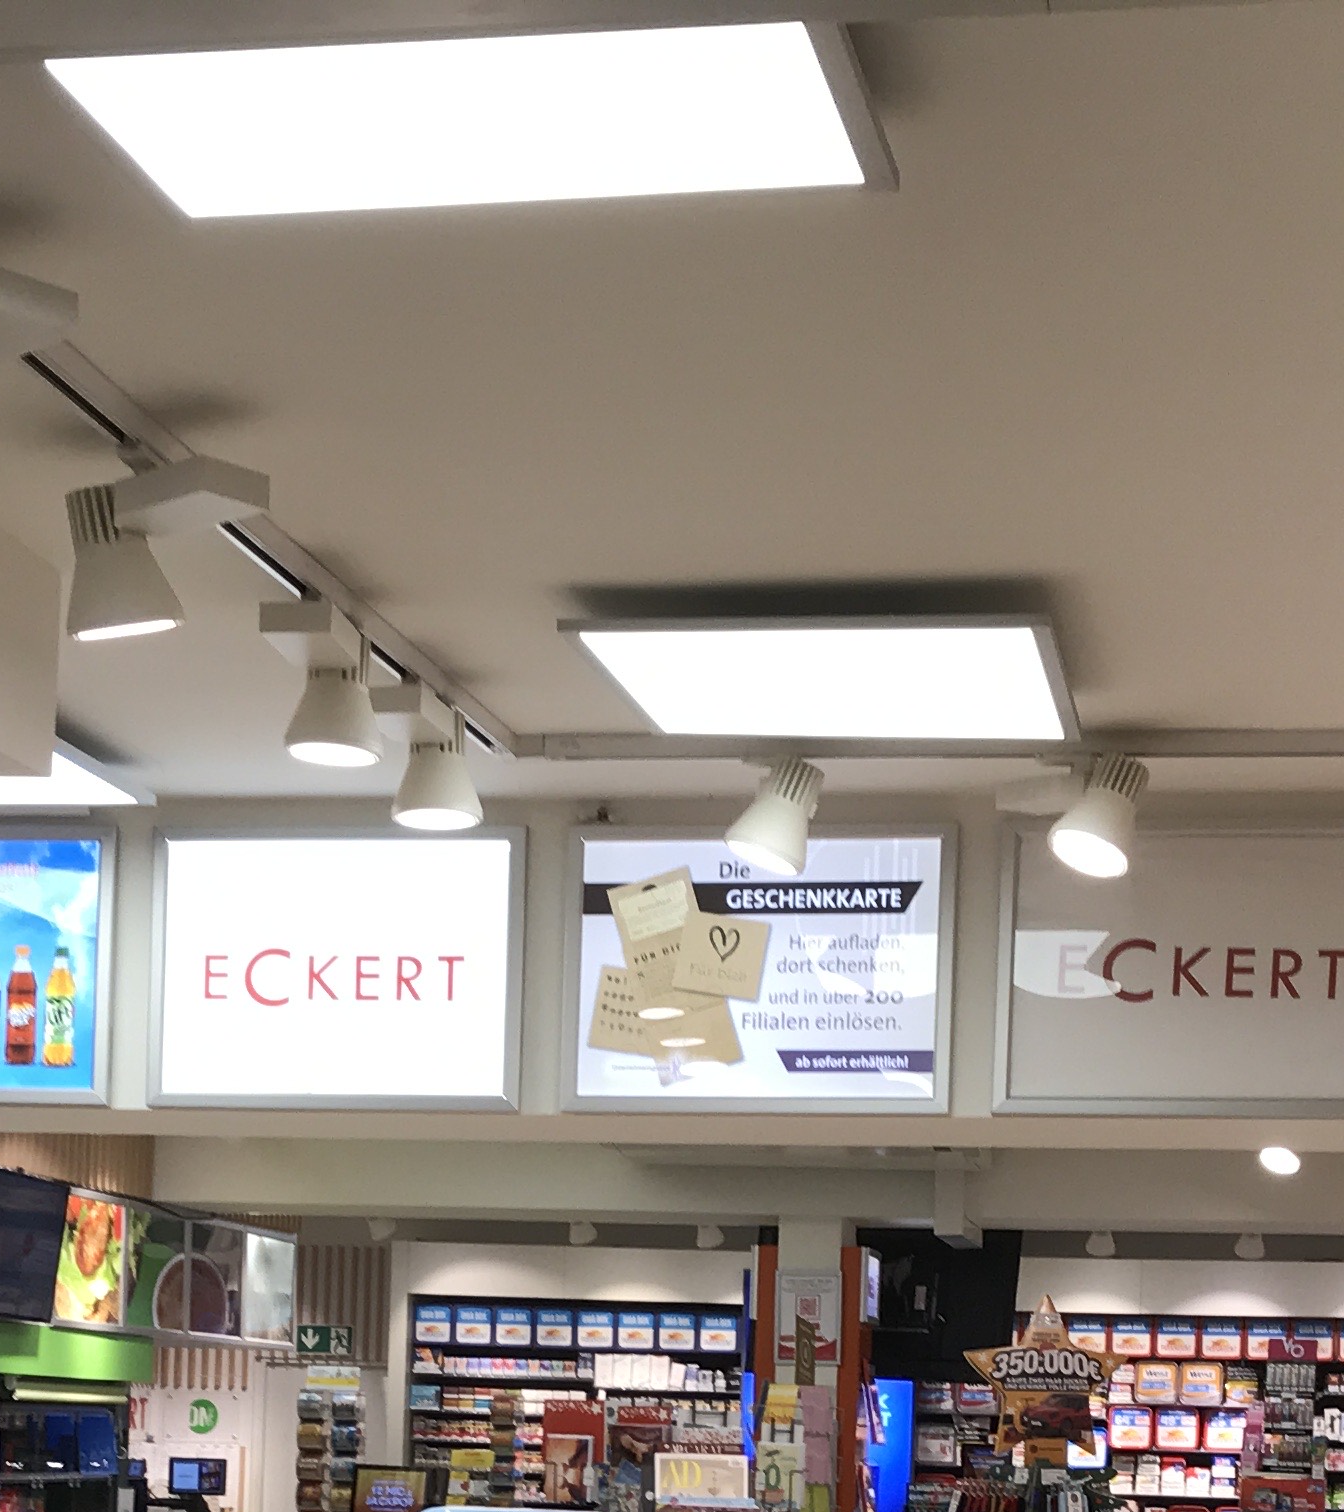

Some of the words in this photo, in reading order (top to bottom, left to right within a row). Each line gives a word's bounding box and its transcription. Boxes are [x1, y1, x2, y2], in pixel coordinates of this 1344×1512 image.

[719, 861, 751, 879] Die
[726, 887, 903, 909] GESCHENKKARTE
[777, 957, 813, 975] dort
[204, 948, 466, 1007] ECKERT
[769, 989, 799, 1005] und
[803, 989, 818, 1005] in
[864, 990, 904, 1005] 200
[742, 1011, 809, 1031] Filialen
[815, 1010, 903, 1032] einlösen.
[795, 1054, 811, 1069] ab
[813, 1054, 847, 1069] sofort
[991, 1350, 1103, 1382] 350.000€
[662, 1460, 703, 1489] AD
